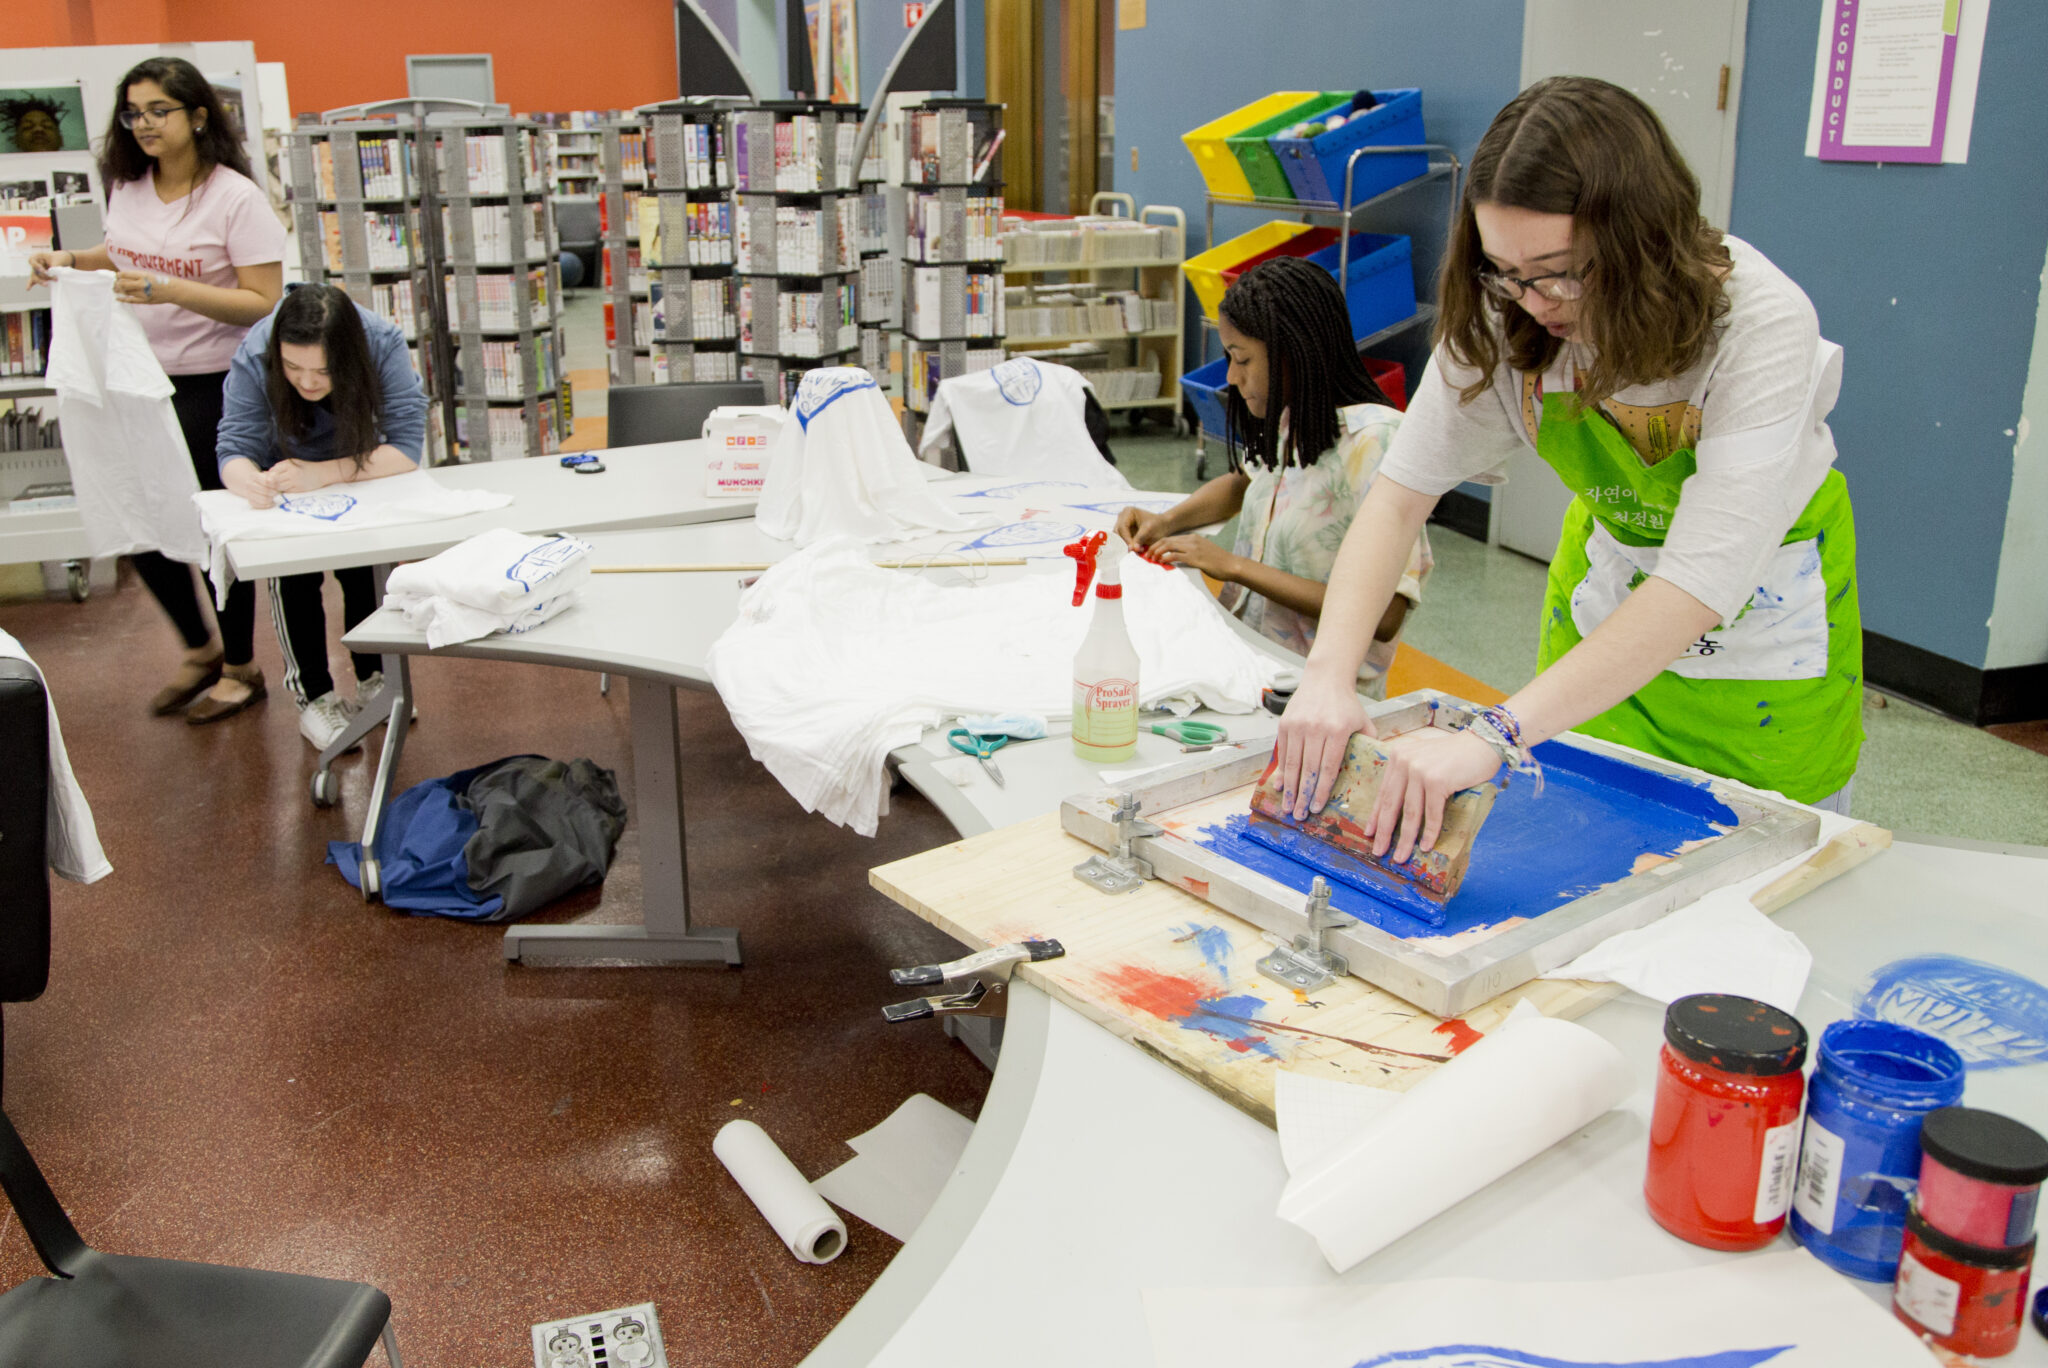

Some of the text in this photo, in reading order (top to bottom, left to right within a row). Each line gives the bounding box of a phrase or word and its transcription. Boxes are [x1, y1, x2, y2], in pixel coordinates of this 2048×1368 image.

[1828, 23, 1850, 143] CONDUCT
[717, 478, 764, 486] MUNCHKI
[1096, 685, 1131, 698] ProSafe
[1095, 698, 1131, 711] Sprayer
